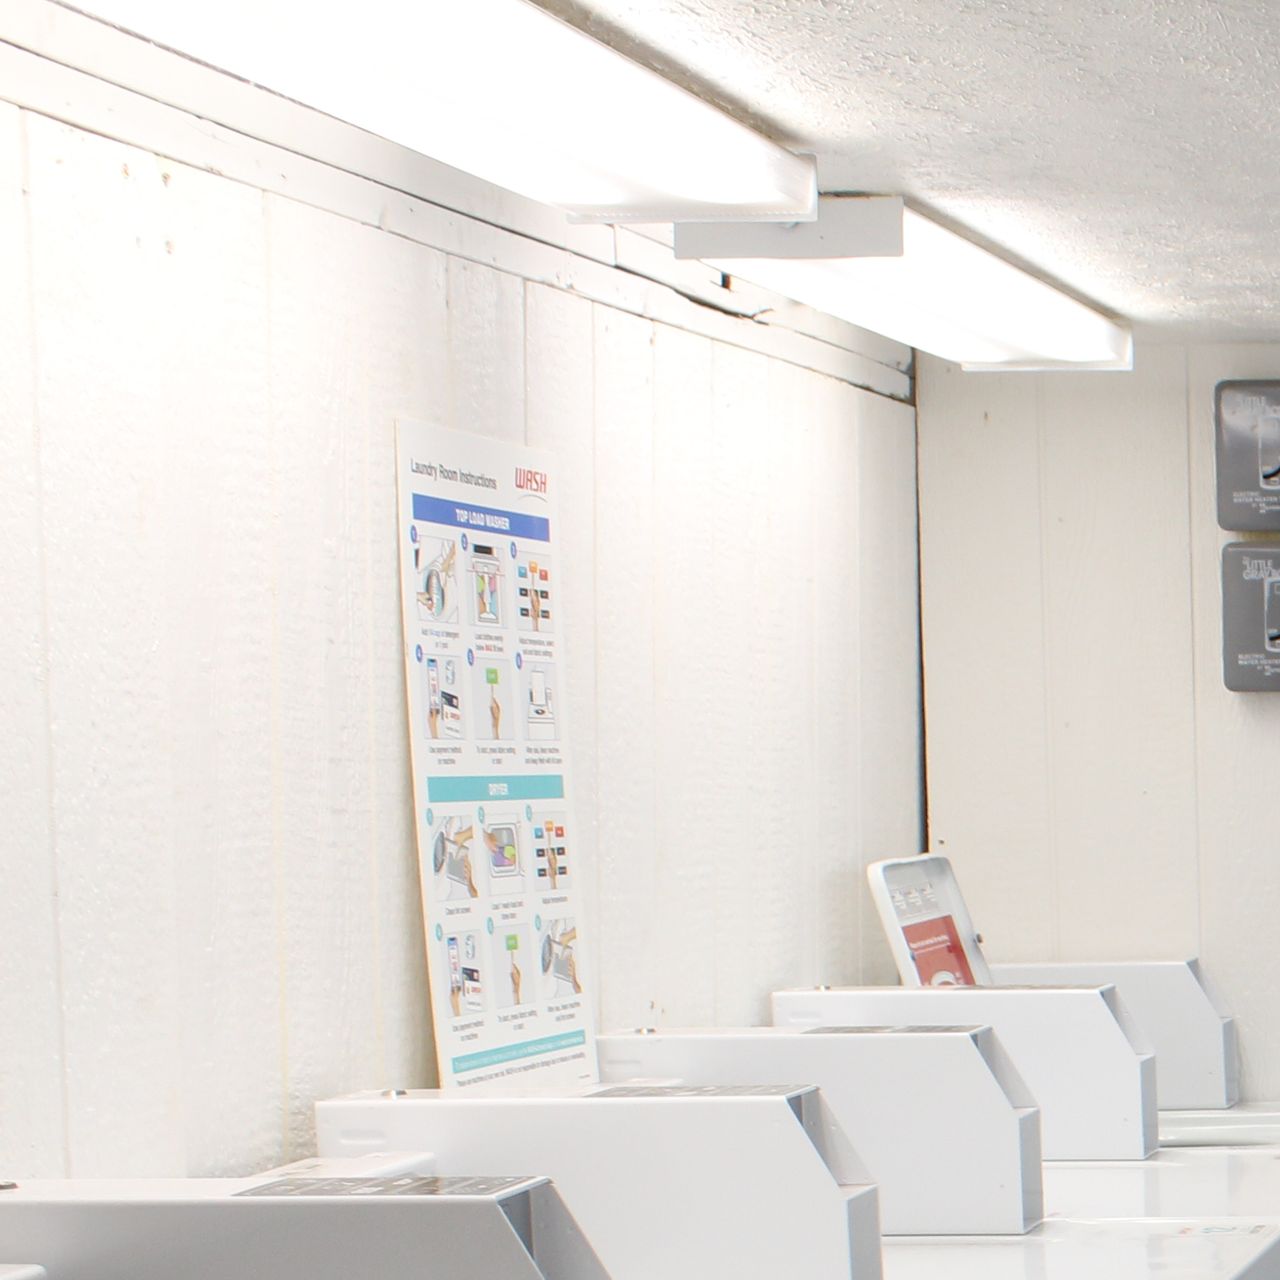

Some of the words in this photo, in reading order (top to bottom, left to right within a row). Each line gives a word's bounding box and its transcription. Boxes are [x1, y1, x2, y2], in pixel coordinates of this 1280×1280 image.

[410, 458, 437, 481] Laundry
[438, 464, 458, 482] Room
[459, 468, 497, 490] Instructions
[514, 467, 547, 493] WASH
[456, 508, 467, 522] TOP
[469, 511, 485, 525] LOAD
[486, 514, 510, 529] WASHER
